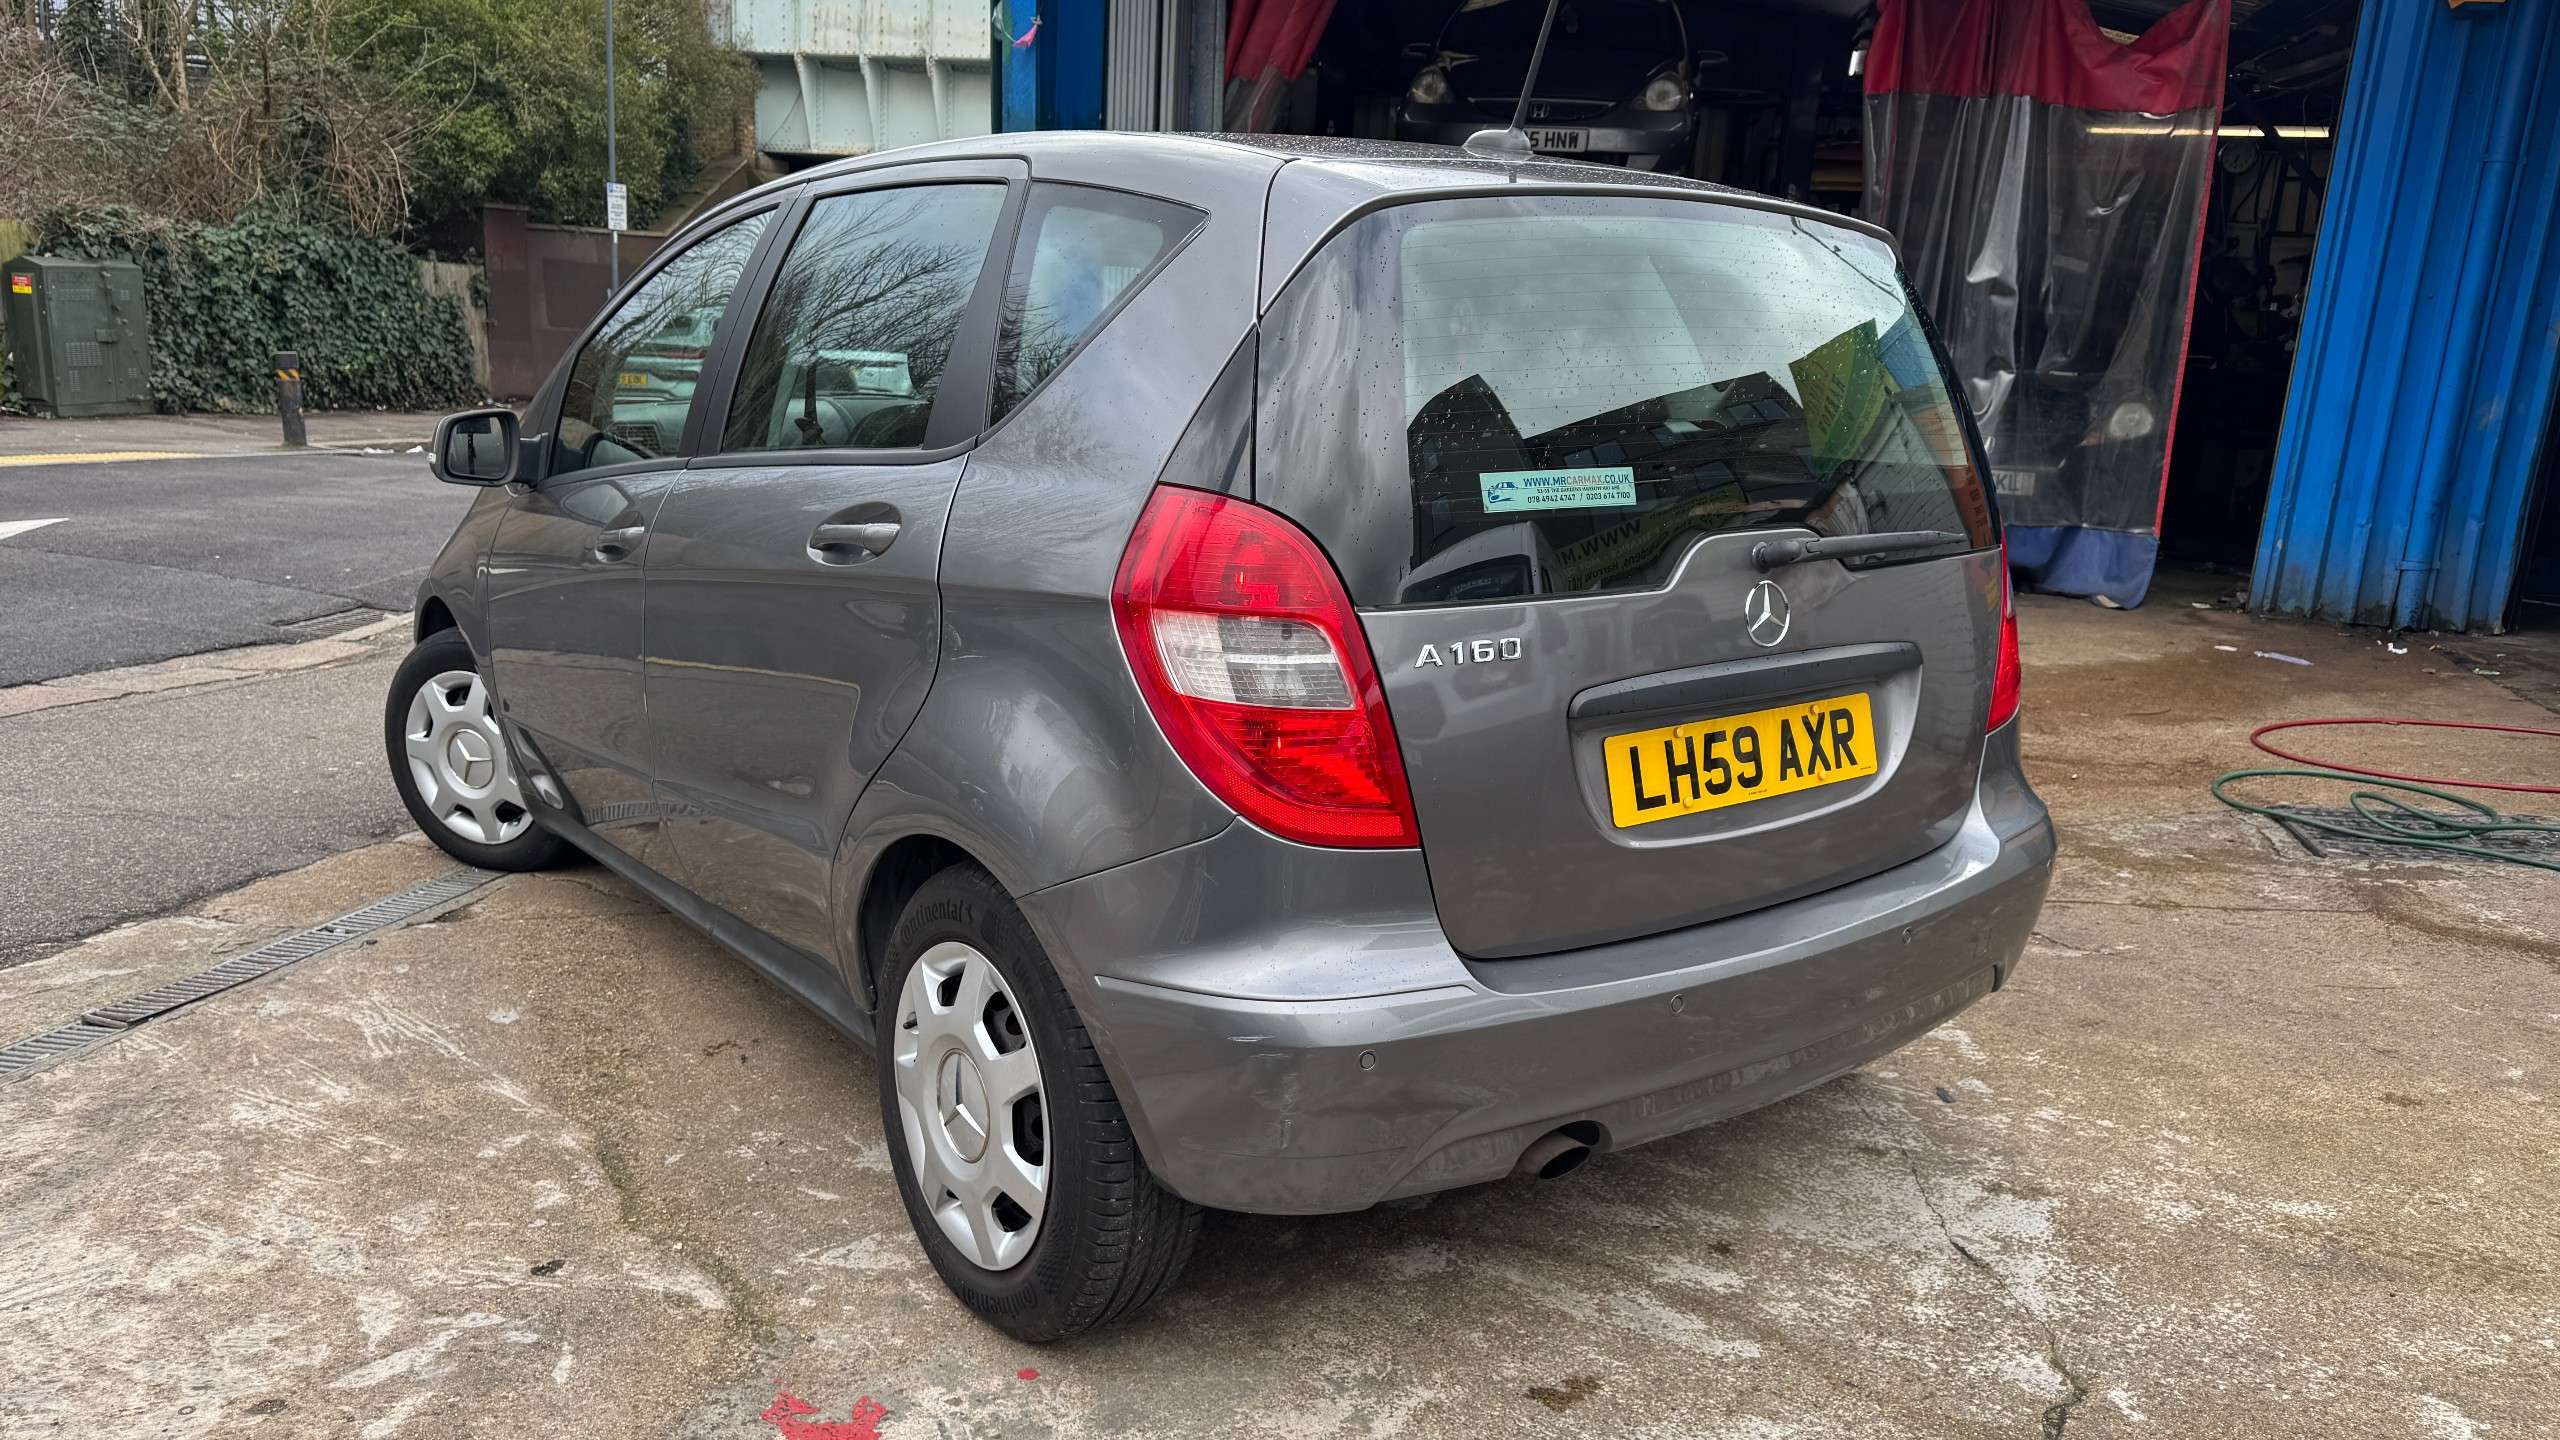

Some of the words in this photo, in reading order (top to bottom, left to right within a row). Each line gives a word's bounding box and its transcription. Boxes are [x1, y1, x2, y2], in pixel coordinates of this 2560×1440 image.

[1525, 131, 1540, 148] 5
[1523, 474, 1630, 487] WWW.MRCARMAX.CO.UK
[1995, 472, 2020, 492] KL
[1527, 495, 1540, 504] 078
[1628, 725, 1764, 812] LH59
[1779, 707, 1858, 782] AXR
